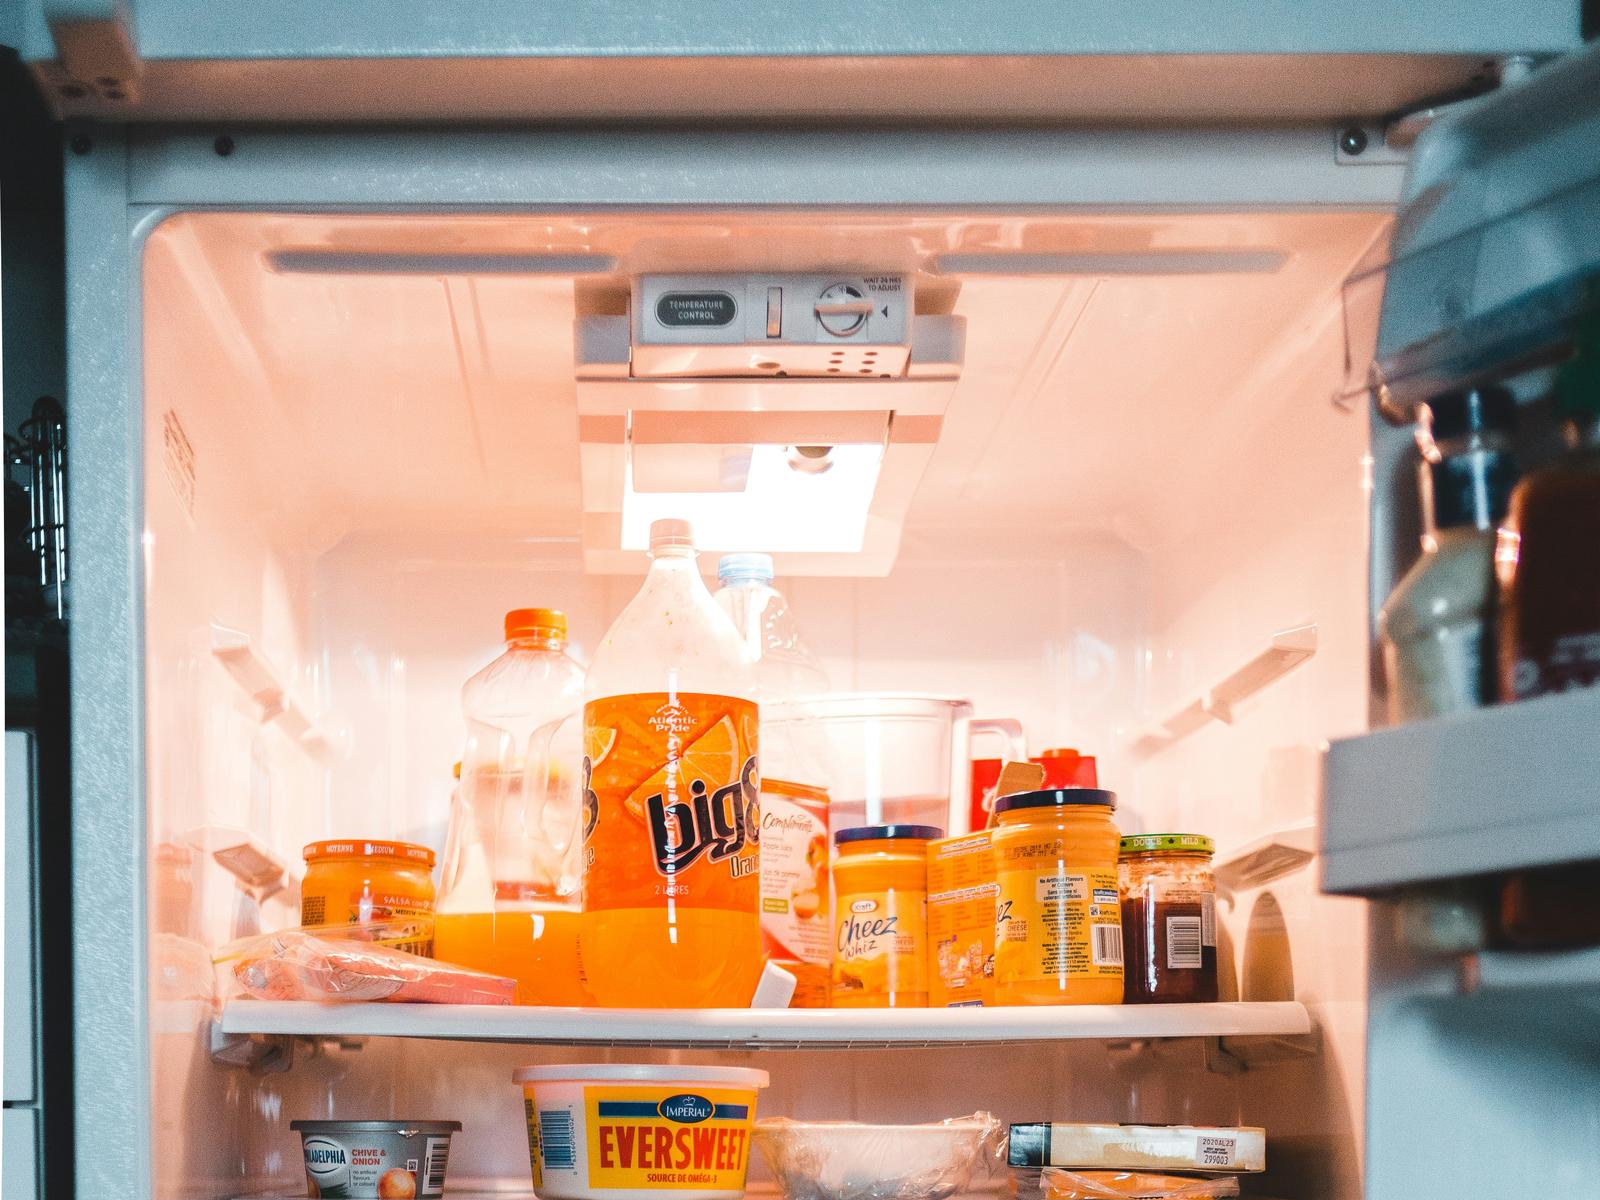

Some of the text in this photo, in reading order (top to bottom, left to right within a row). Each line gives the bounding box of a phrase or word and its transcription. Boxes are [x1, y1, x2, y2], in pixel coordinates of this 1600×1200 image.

[669, 301, 723, 310] TEMPERATURE
[678, 311, 714, 320] CONTROL
[1181, 836, 1199, 846] MILD
[366, 845, 395, 855] EDIUM
[655, 884, 660, 895] 2
[383, 896, 411, 905] SALSA
[854, 902, 872, 911] Kraft
[666, 1105, 709, 1118] IMPERIAL
[352, 1149, 386, 1157] CHIVE &
[600, 1125, 746, 1171] EVERSWEET
[352, 1158, 380, 1166] ONION
[1204, 1154, 1229, 1165] 299003
[647, 1173, 676, 1183] SOURCE
[677, 1173, 687, 1183] DE
